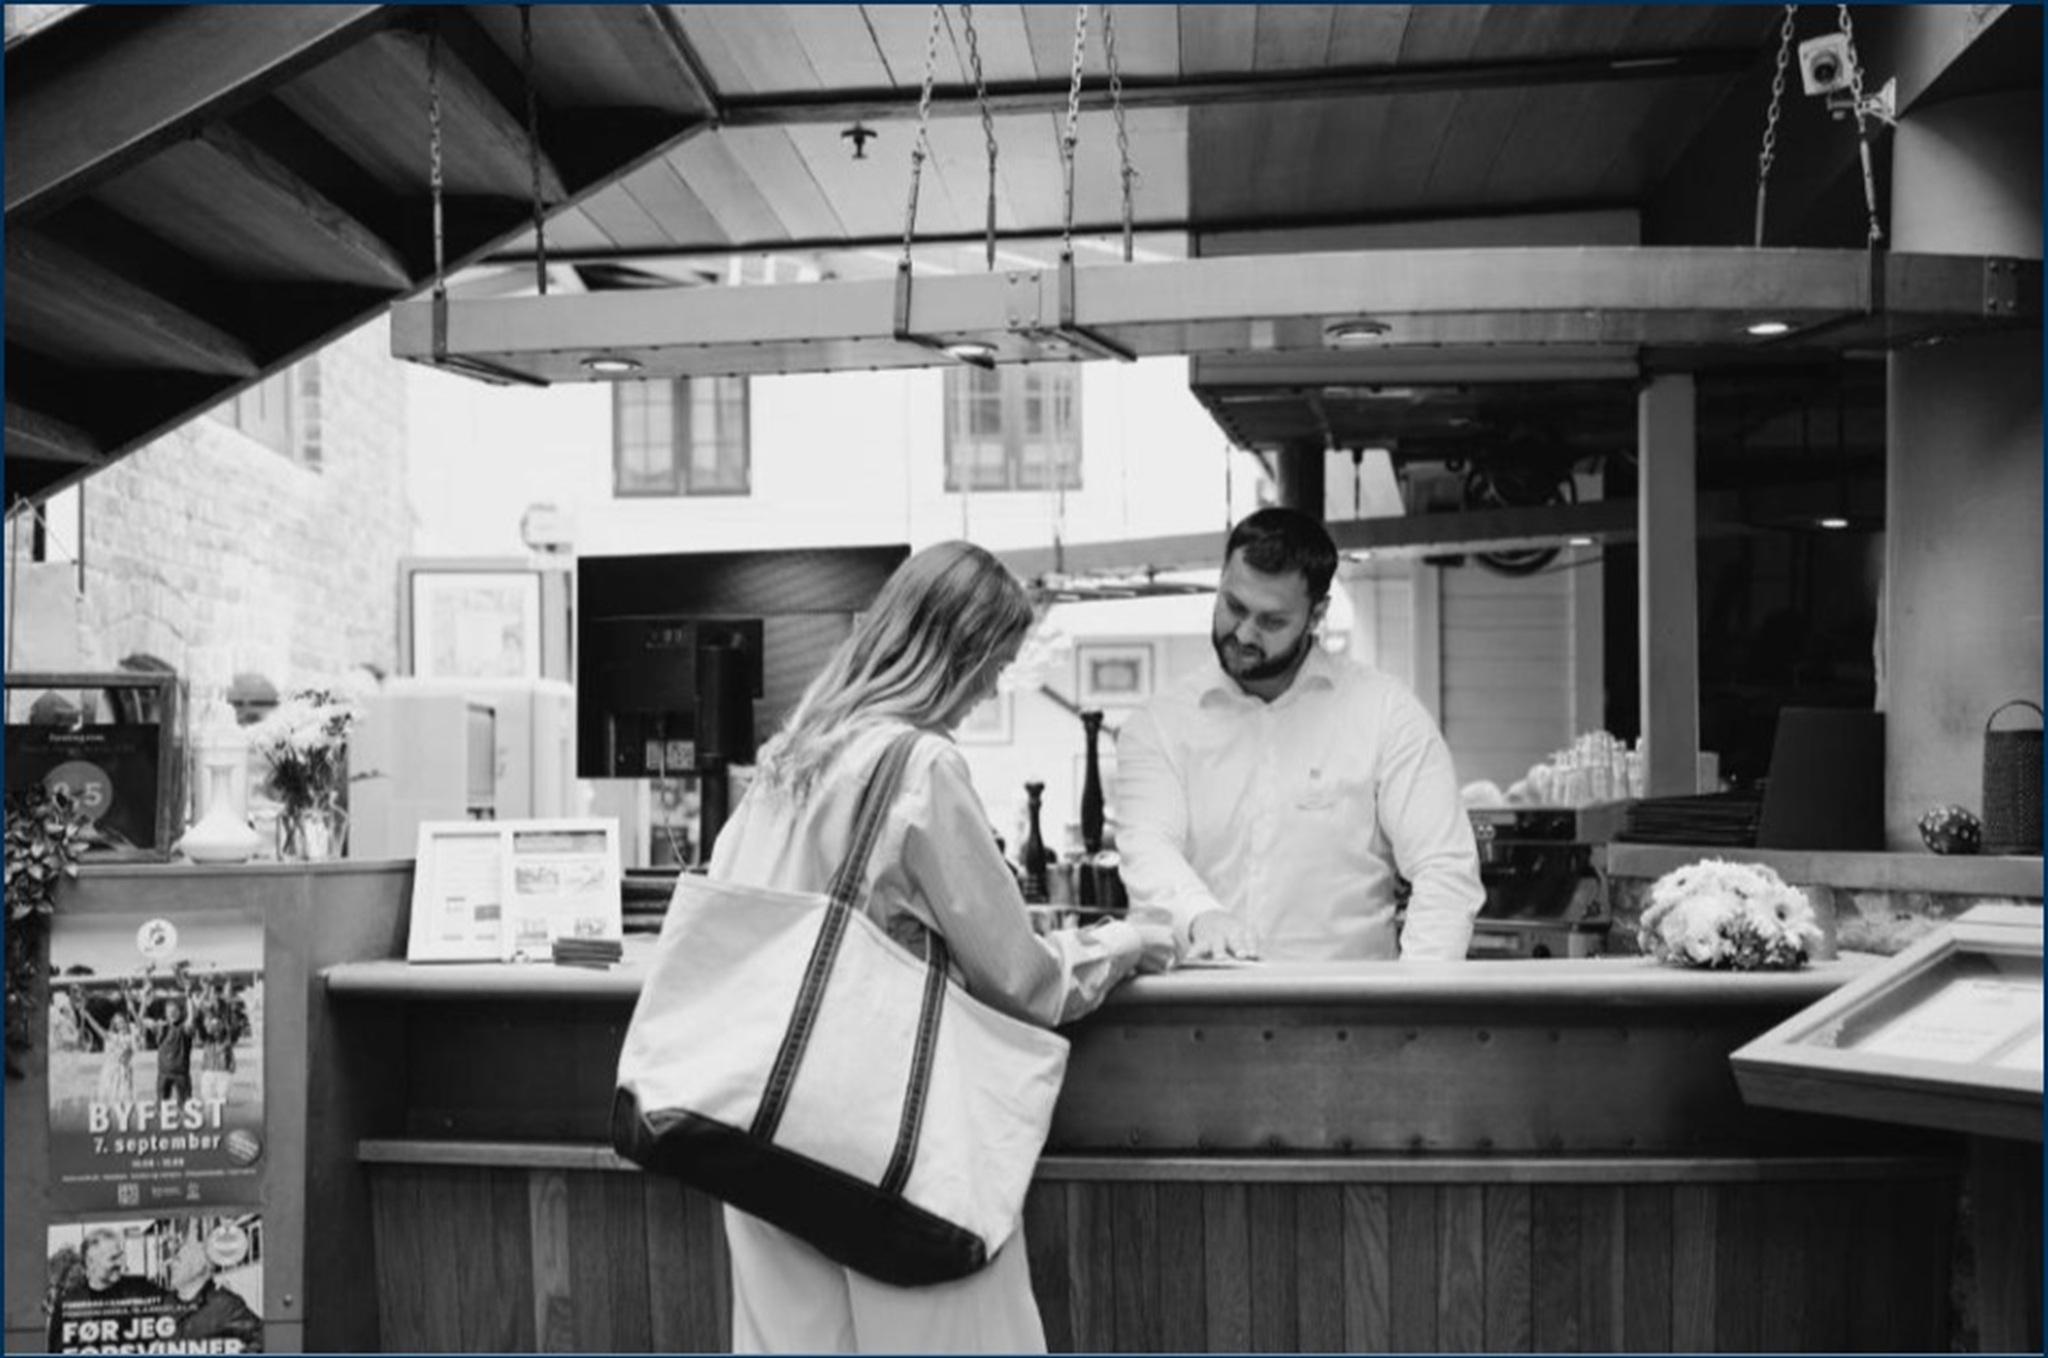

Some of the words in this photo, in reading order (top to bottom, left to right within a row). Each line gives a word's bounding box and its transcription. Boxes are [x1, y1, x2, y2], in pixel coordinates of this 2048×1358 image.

[88, 1097, 226, 1133] BYFEST
[93, 1137, 108, 1153] 7.
[114, 1133, 221, 1155] september
[62, 1319, 119, 1343] FØR
[123, 1316, 176, 1339] JEG
